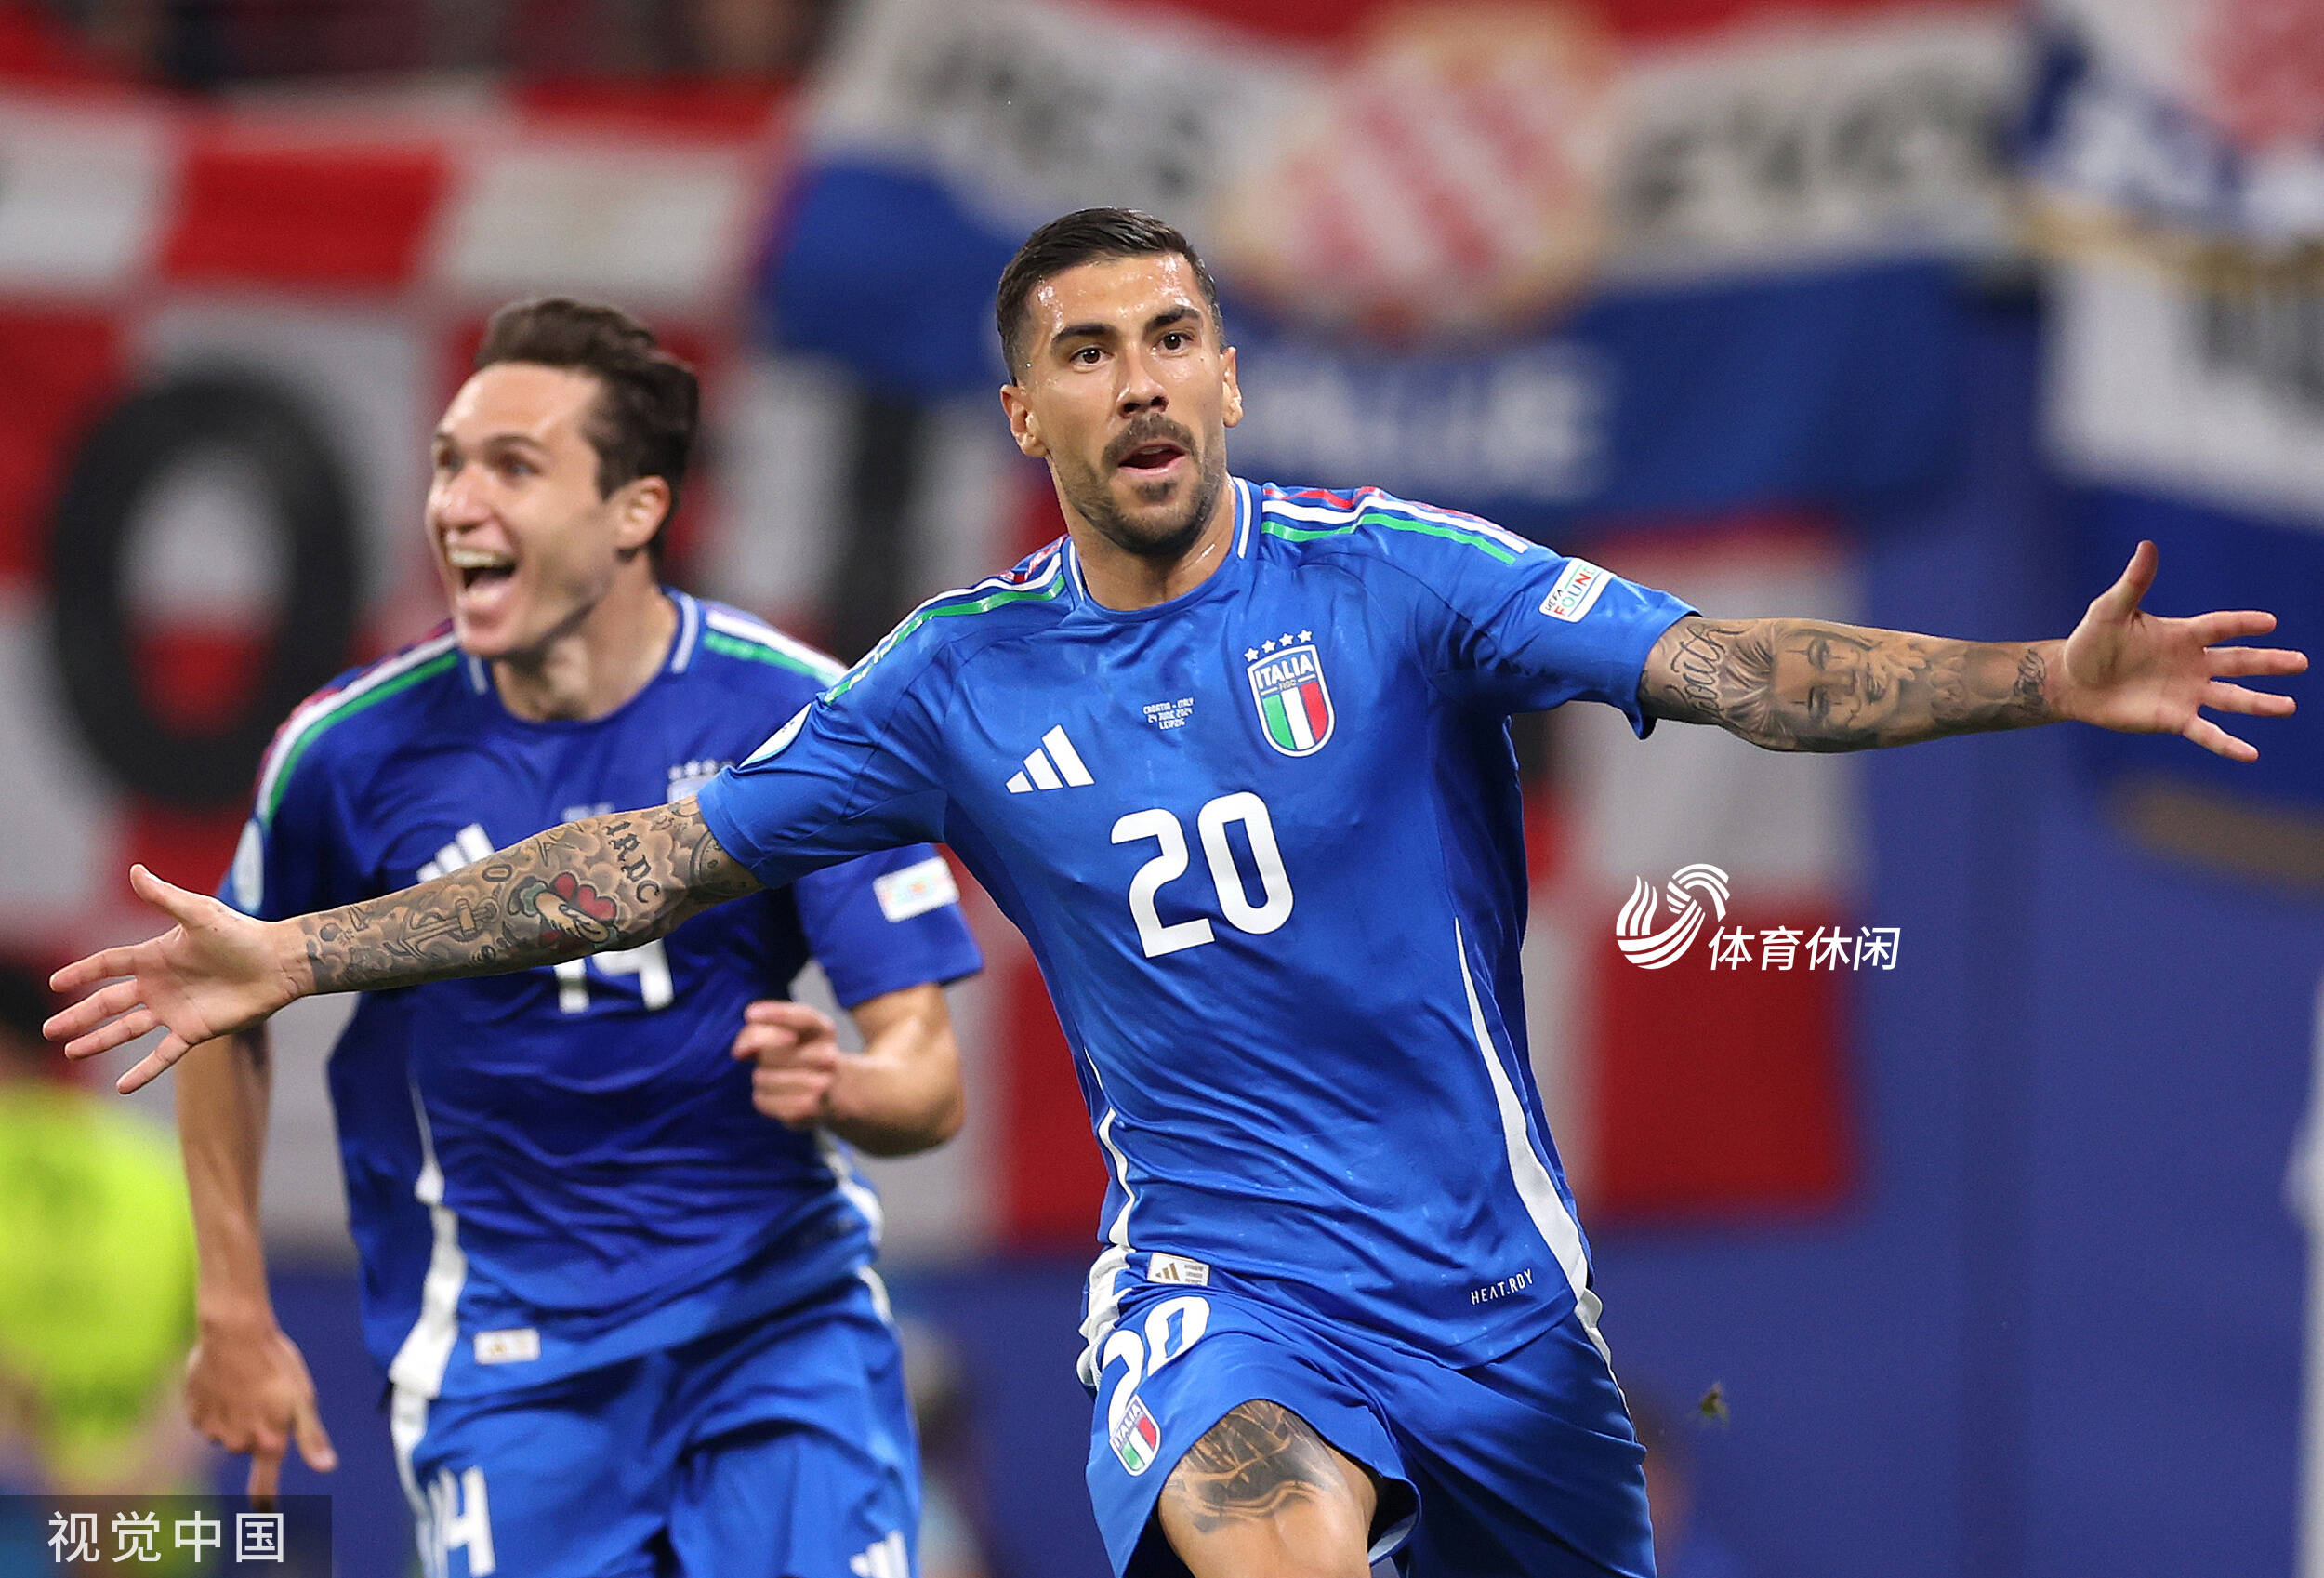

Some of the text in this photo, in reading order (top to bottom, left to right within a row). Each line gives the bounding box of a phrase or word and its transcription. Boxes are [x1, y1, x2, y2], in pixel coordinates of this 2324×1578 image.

[1545, 590, 1563, 611] UEFA
[1255, 654, 1314, 690] ITALIA
[1143, 702, 1171, 714] CROATIA
[1177, 697, 1194, 708] ITALY
[1159, 718, 1185, 730] LEIPZIG
[1110, 791, 1294, 958] 20
[1470, 1268, 1533, 1306] HEAT.RDY
[1103, 1295, 1211, 1438] 20
[1113, 1402, 1142, 1449] ITALIA
